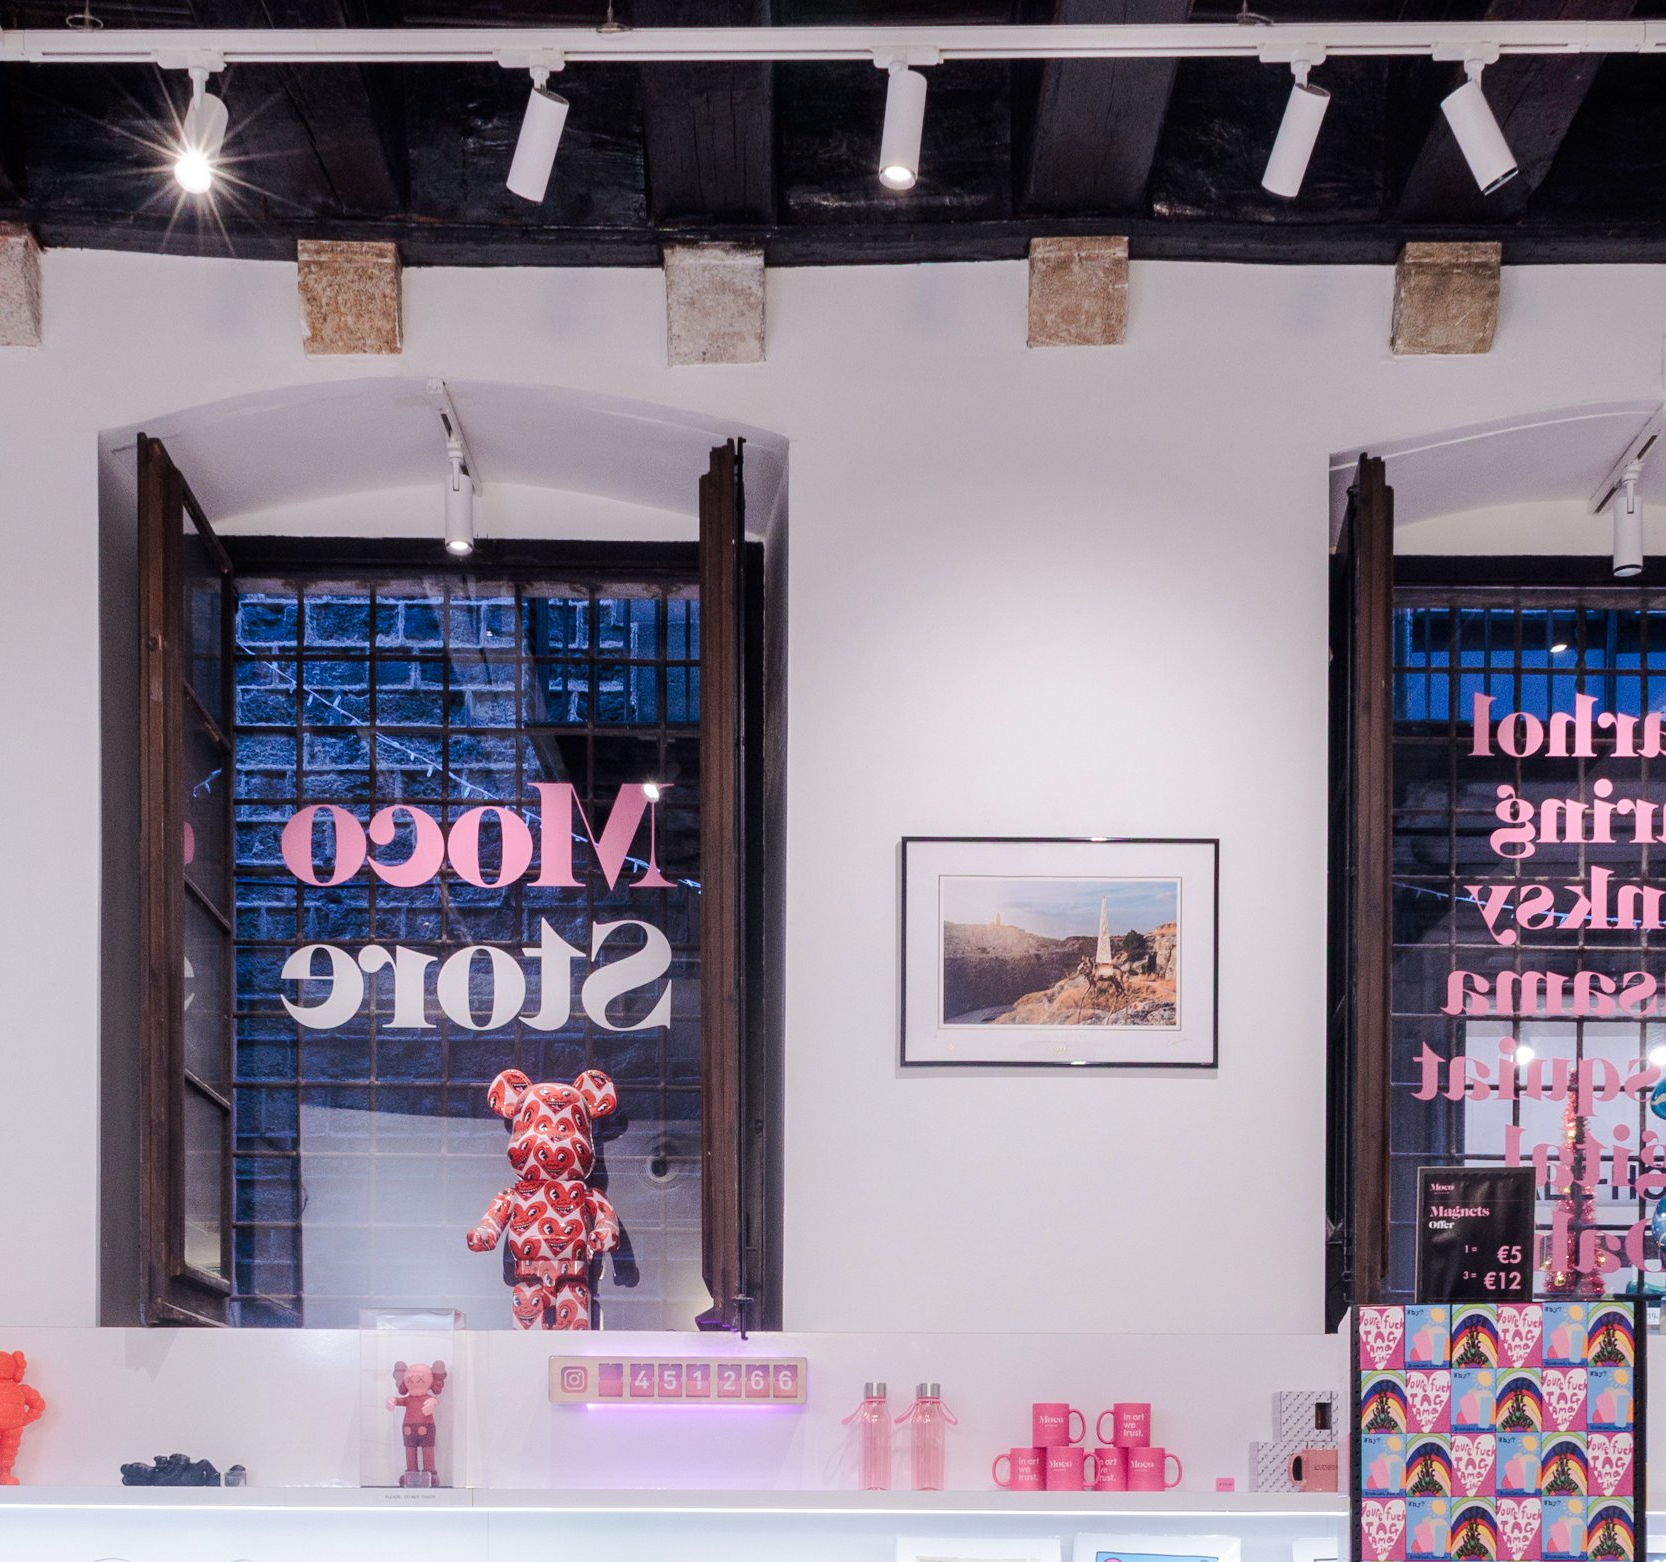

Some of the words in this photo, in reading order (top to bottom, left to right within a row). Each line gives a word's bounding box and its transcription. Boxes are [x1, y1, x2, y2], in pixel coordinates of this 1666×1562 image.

[1430, 1182, 1455, 1193] Moco
[1429, 1205, 1491, 1219] Magnets
[1428, 1219, 1455, 1230] Offer
[1496, 1245, 1522, 1265] €5
[1483, 1271, 1522, 1291] €12
[1039, 1415, 1064, 1424] Moco
[1123, 1413, 1131, 1421] In
[1133, 1413, 1145, 1421] art
[1123, 1429, 1144, 1437] trust.
[1028, 1458, 1039, 1466] art
[1049, 1459, 1073, 1468] Moco
[1105, 1458, 1117, 1466] art
[1130, 1459, 1154, 1468] Moco
[1018, 1474, 1038, 1482] trust.
[1099, 1474, 1117, 1482] rust.
